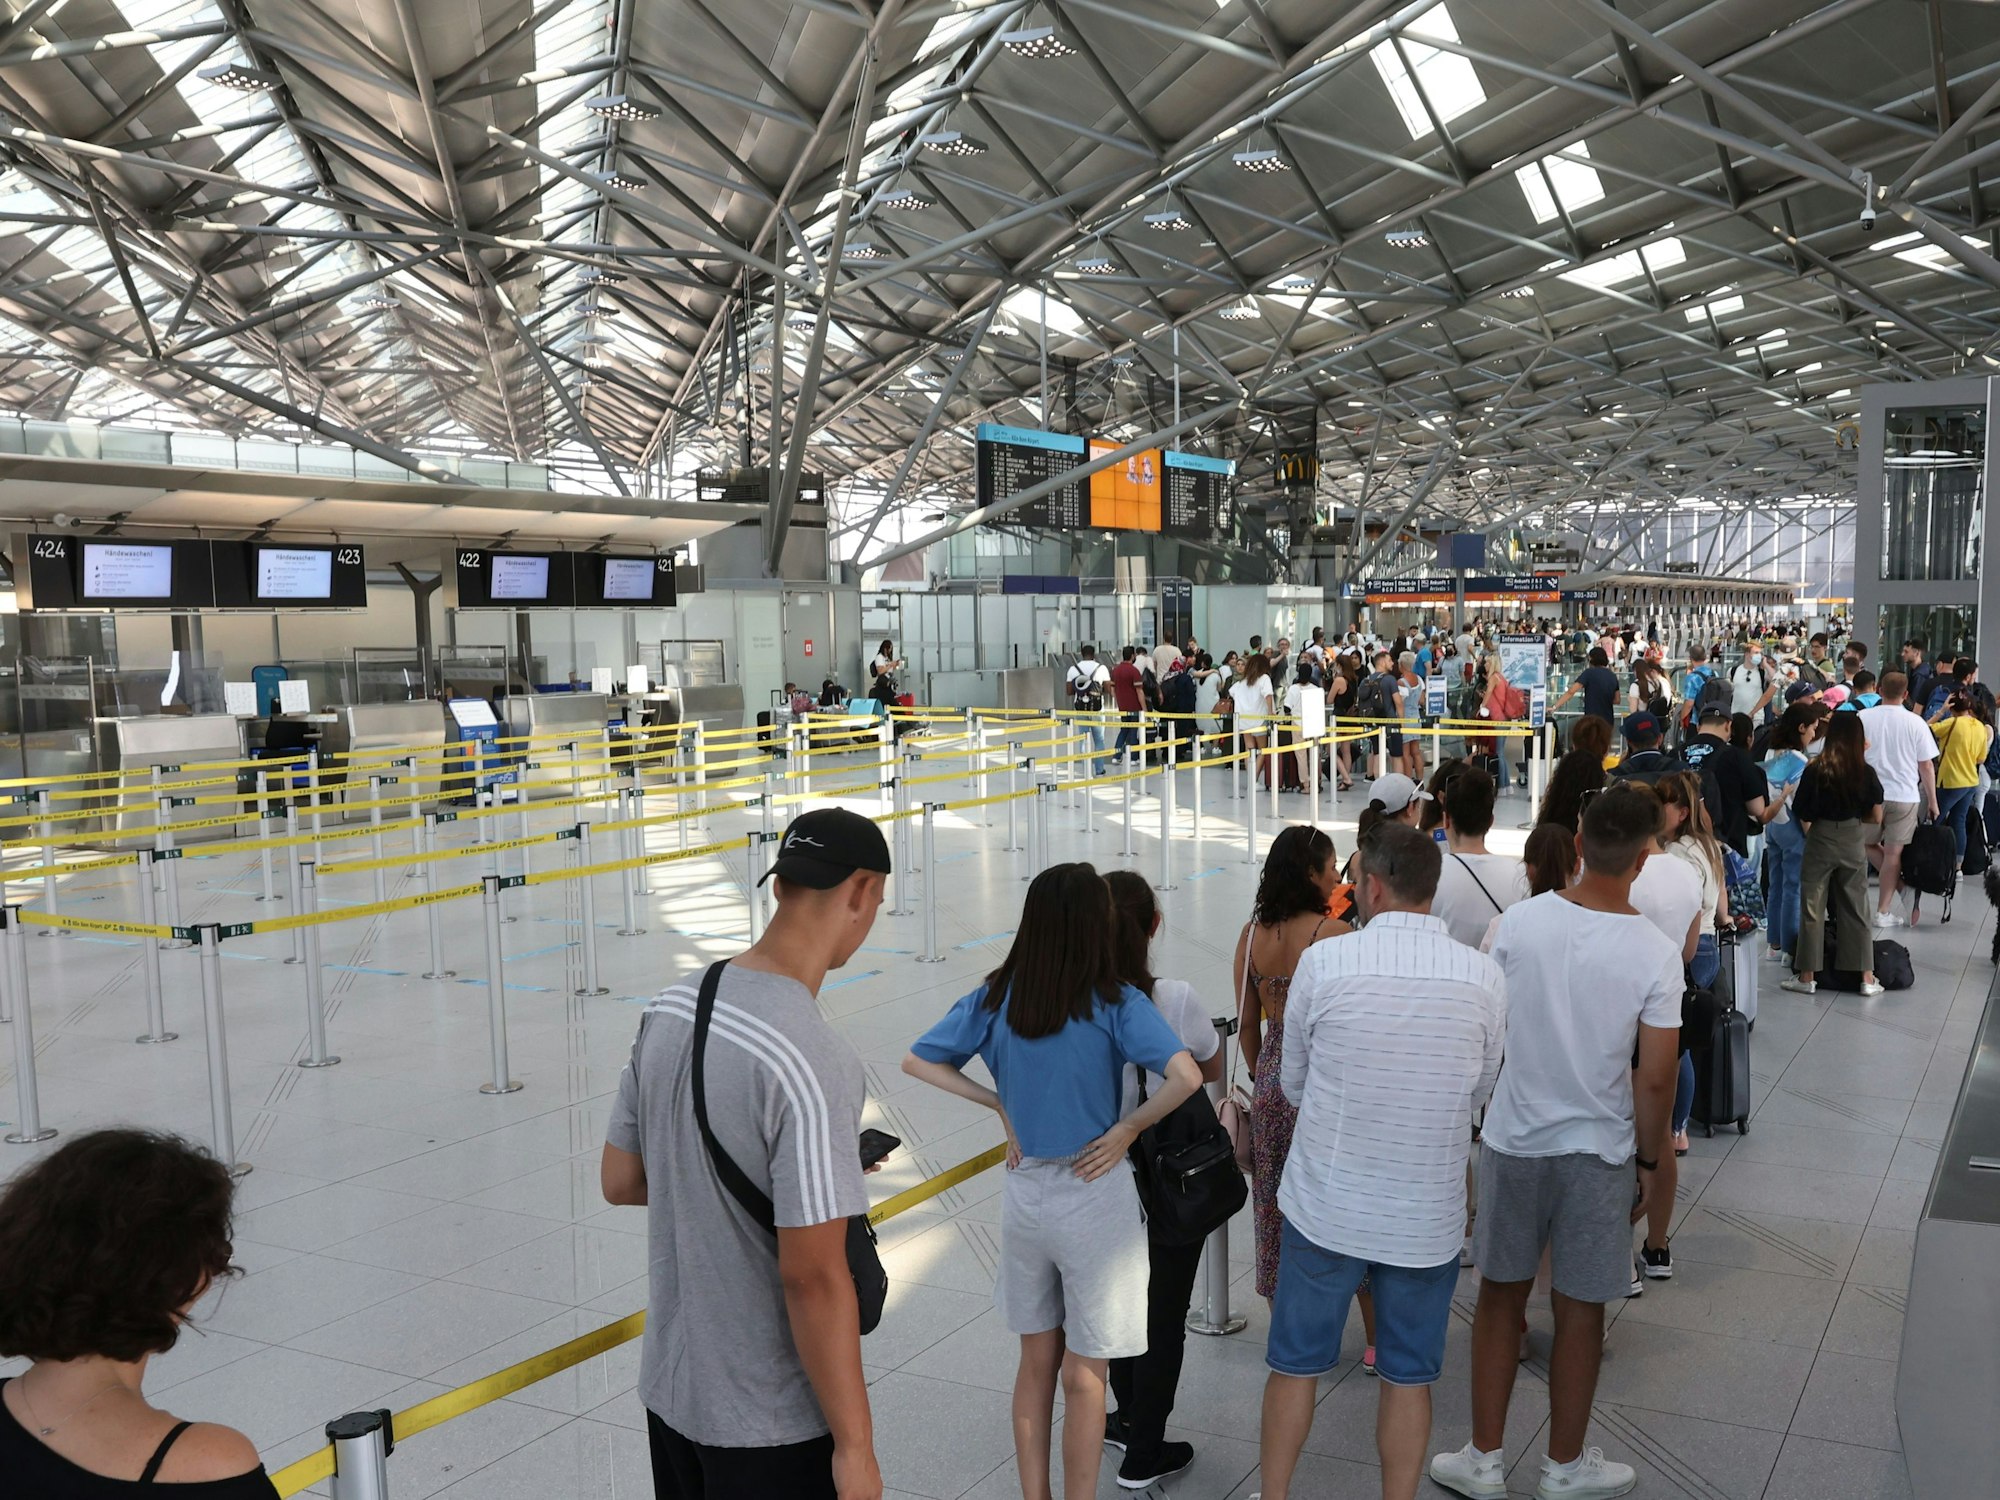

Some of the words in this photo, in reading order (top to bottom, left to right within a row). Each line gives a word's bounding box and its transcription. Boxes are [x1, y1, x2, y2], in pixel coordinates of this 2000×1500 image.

[34, 540, 66, 558] 424
[337, 549, 361, 565] 423
[459, 553, 480, 568] 422
[657, 559, 673, 572] 421
[447, 890, 461, 898] Airport
